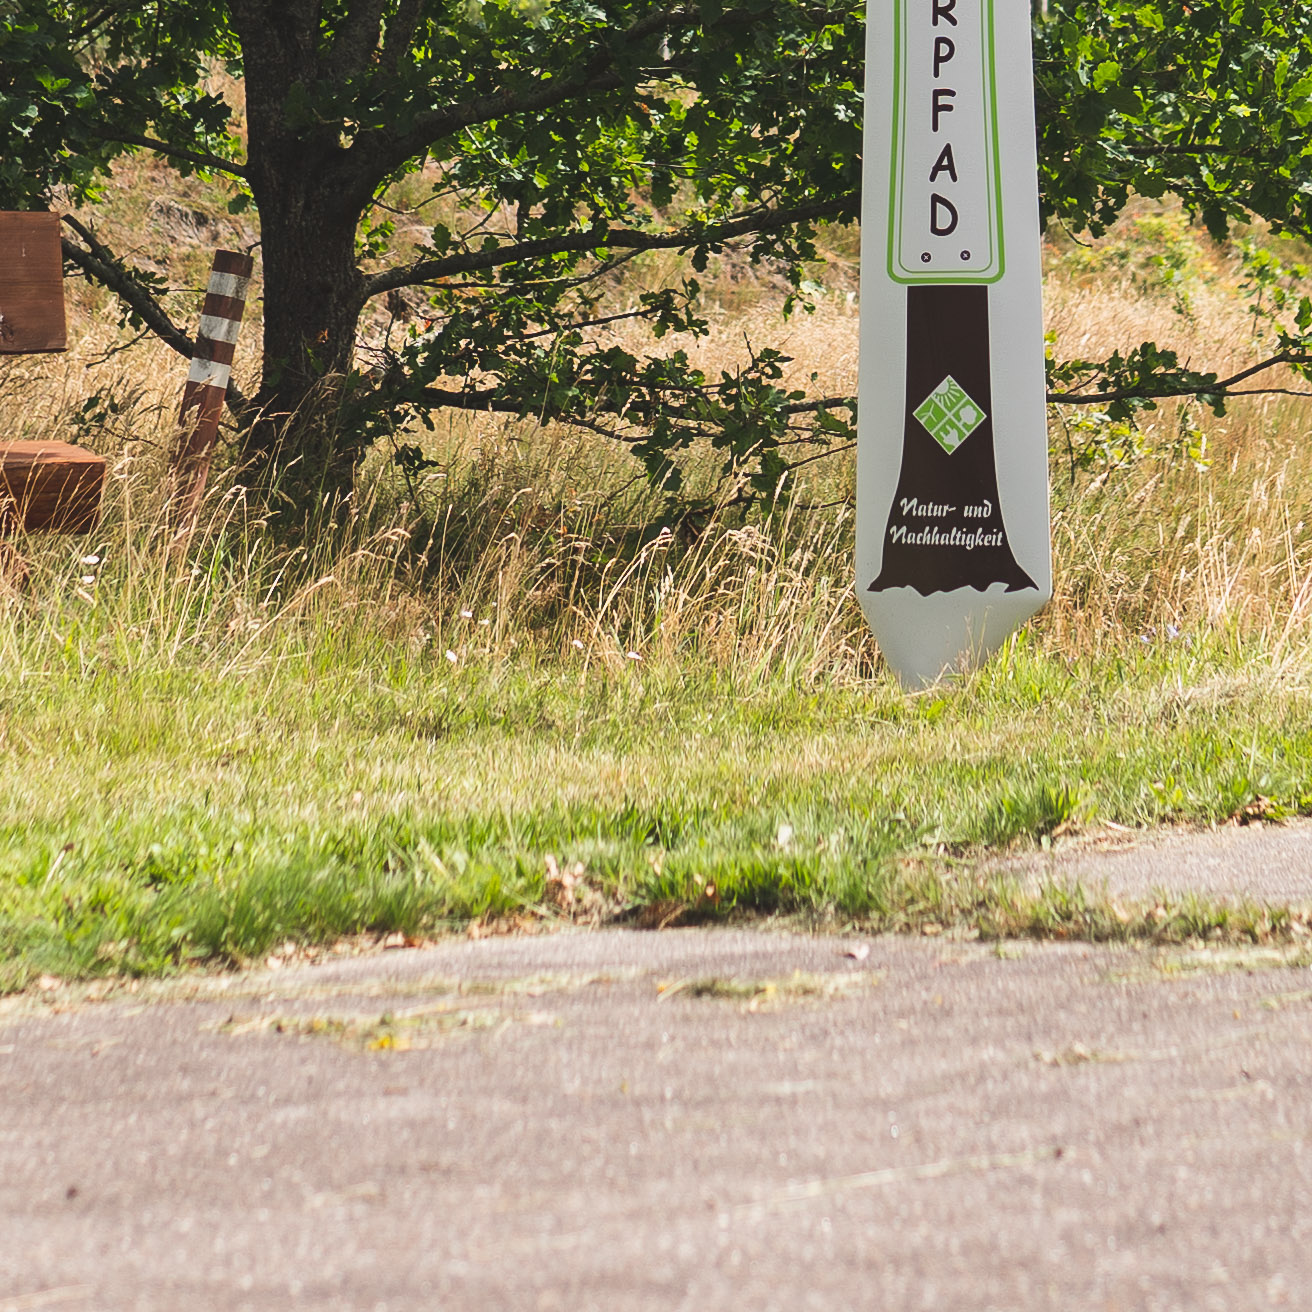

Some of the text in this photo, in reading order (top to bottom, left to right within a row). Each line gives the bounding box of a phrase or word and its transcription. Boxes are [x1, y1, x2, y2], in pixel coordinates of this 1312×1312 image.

[900, 498, 992, 518] Natur- und
[890, 525, 1003, 550] Nachhaltigkeit
